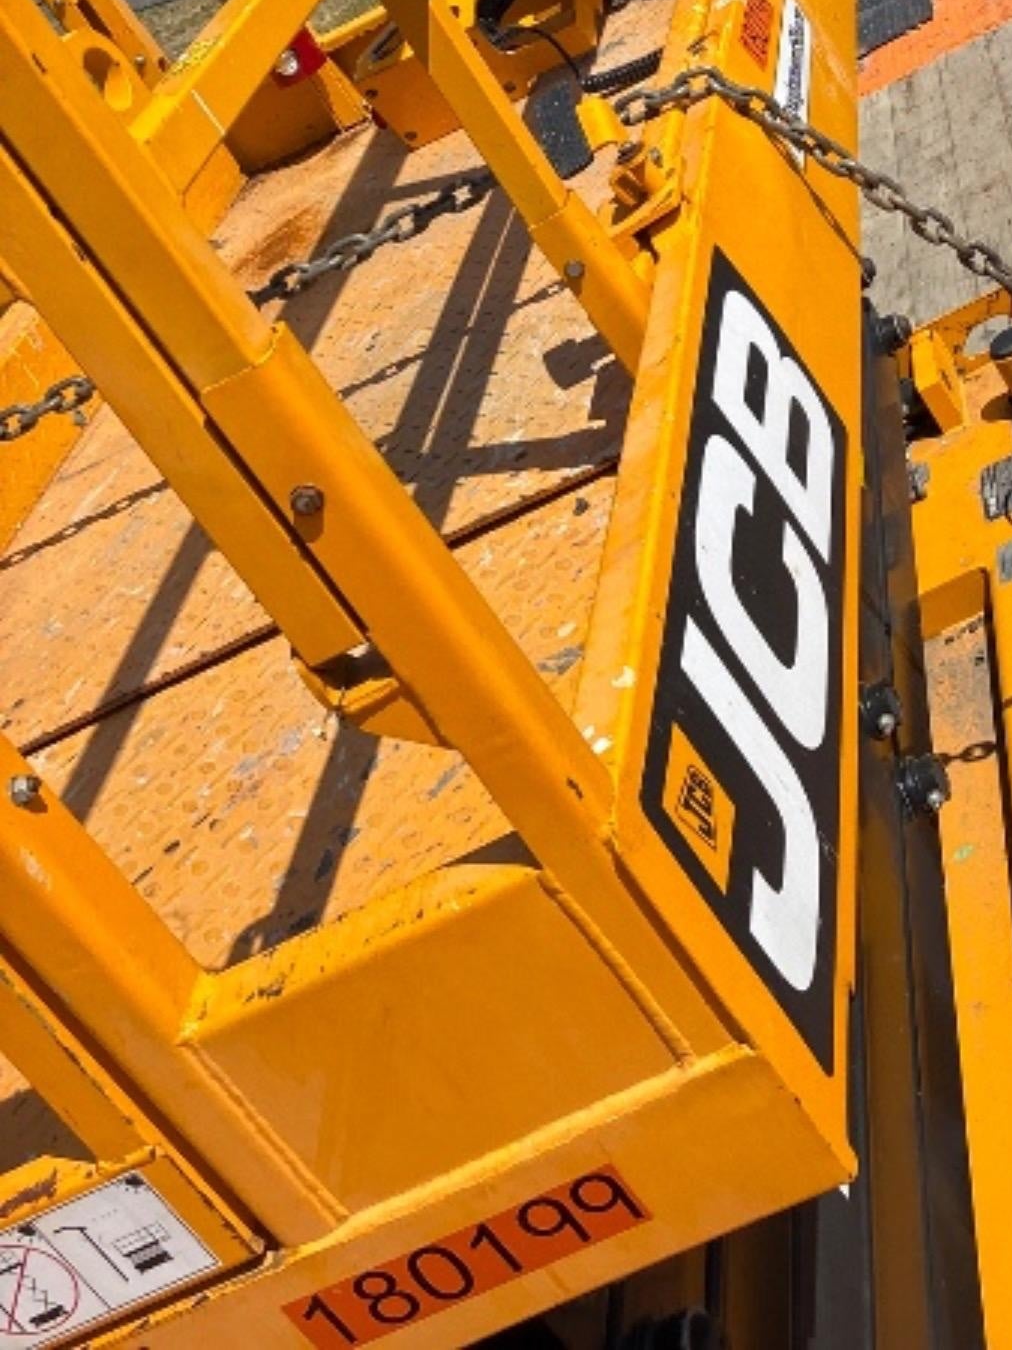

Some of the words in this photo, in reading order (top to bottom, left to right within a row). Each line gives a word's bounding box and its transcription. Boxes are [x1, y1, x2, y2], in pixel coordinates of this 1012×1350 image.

[680, 289, 835, 993] JCB
[679, 769, 715, 843] JCB
[303, 1172, 645, 1344] 180199
